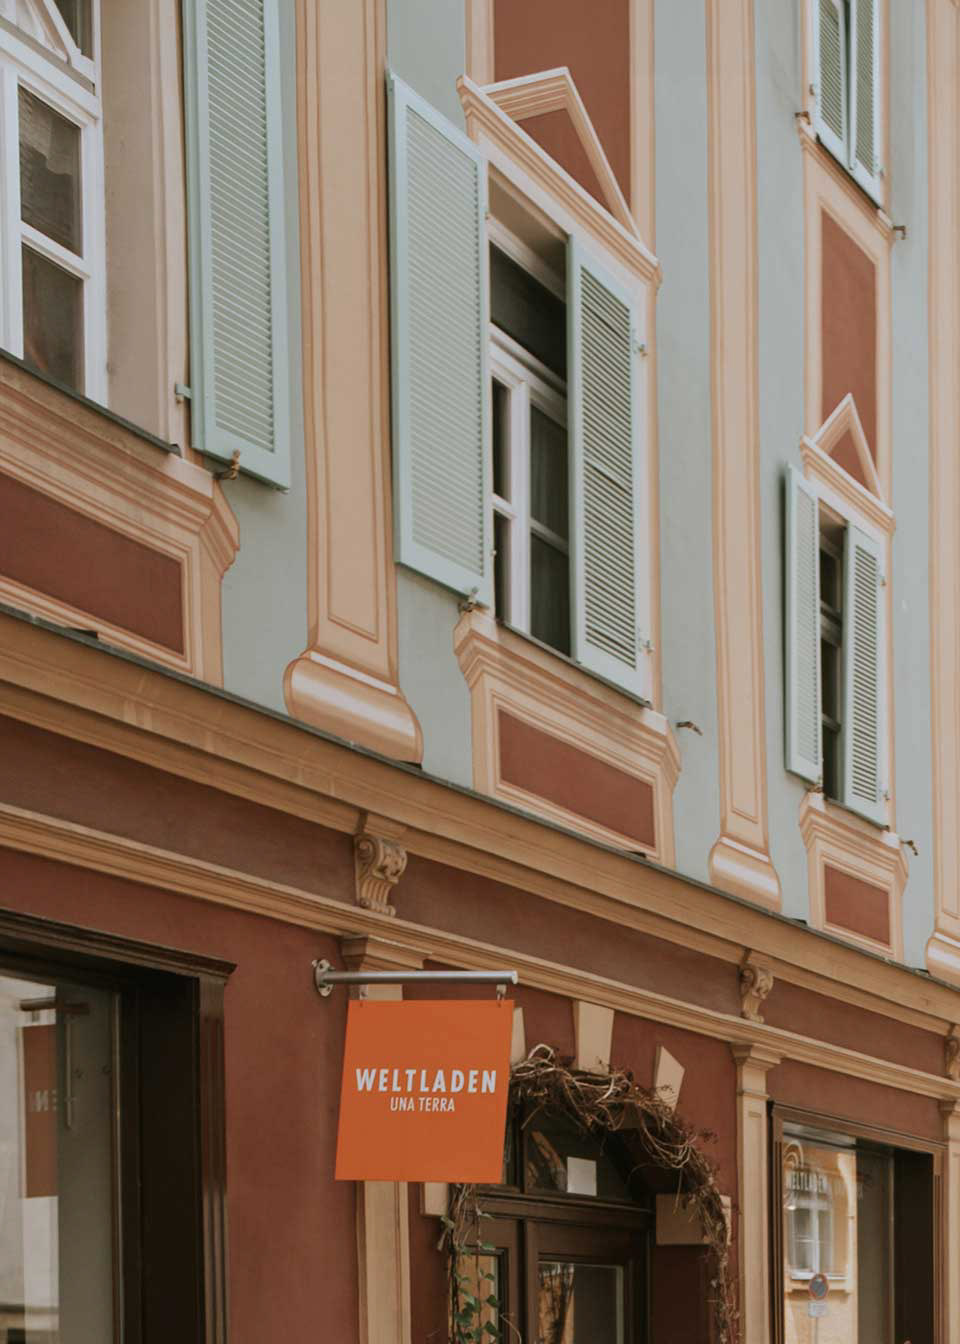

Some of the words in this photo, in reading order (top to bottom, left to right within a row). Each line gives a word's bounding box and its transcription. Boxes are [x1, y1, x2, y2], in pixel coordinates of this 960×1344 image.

[355, 1068, 497, 1093] WELTLADEN
[390, 1097, 415, 1111] UNA
[418, 1097, 455, 1112] TERRA
